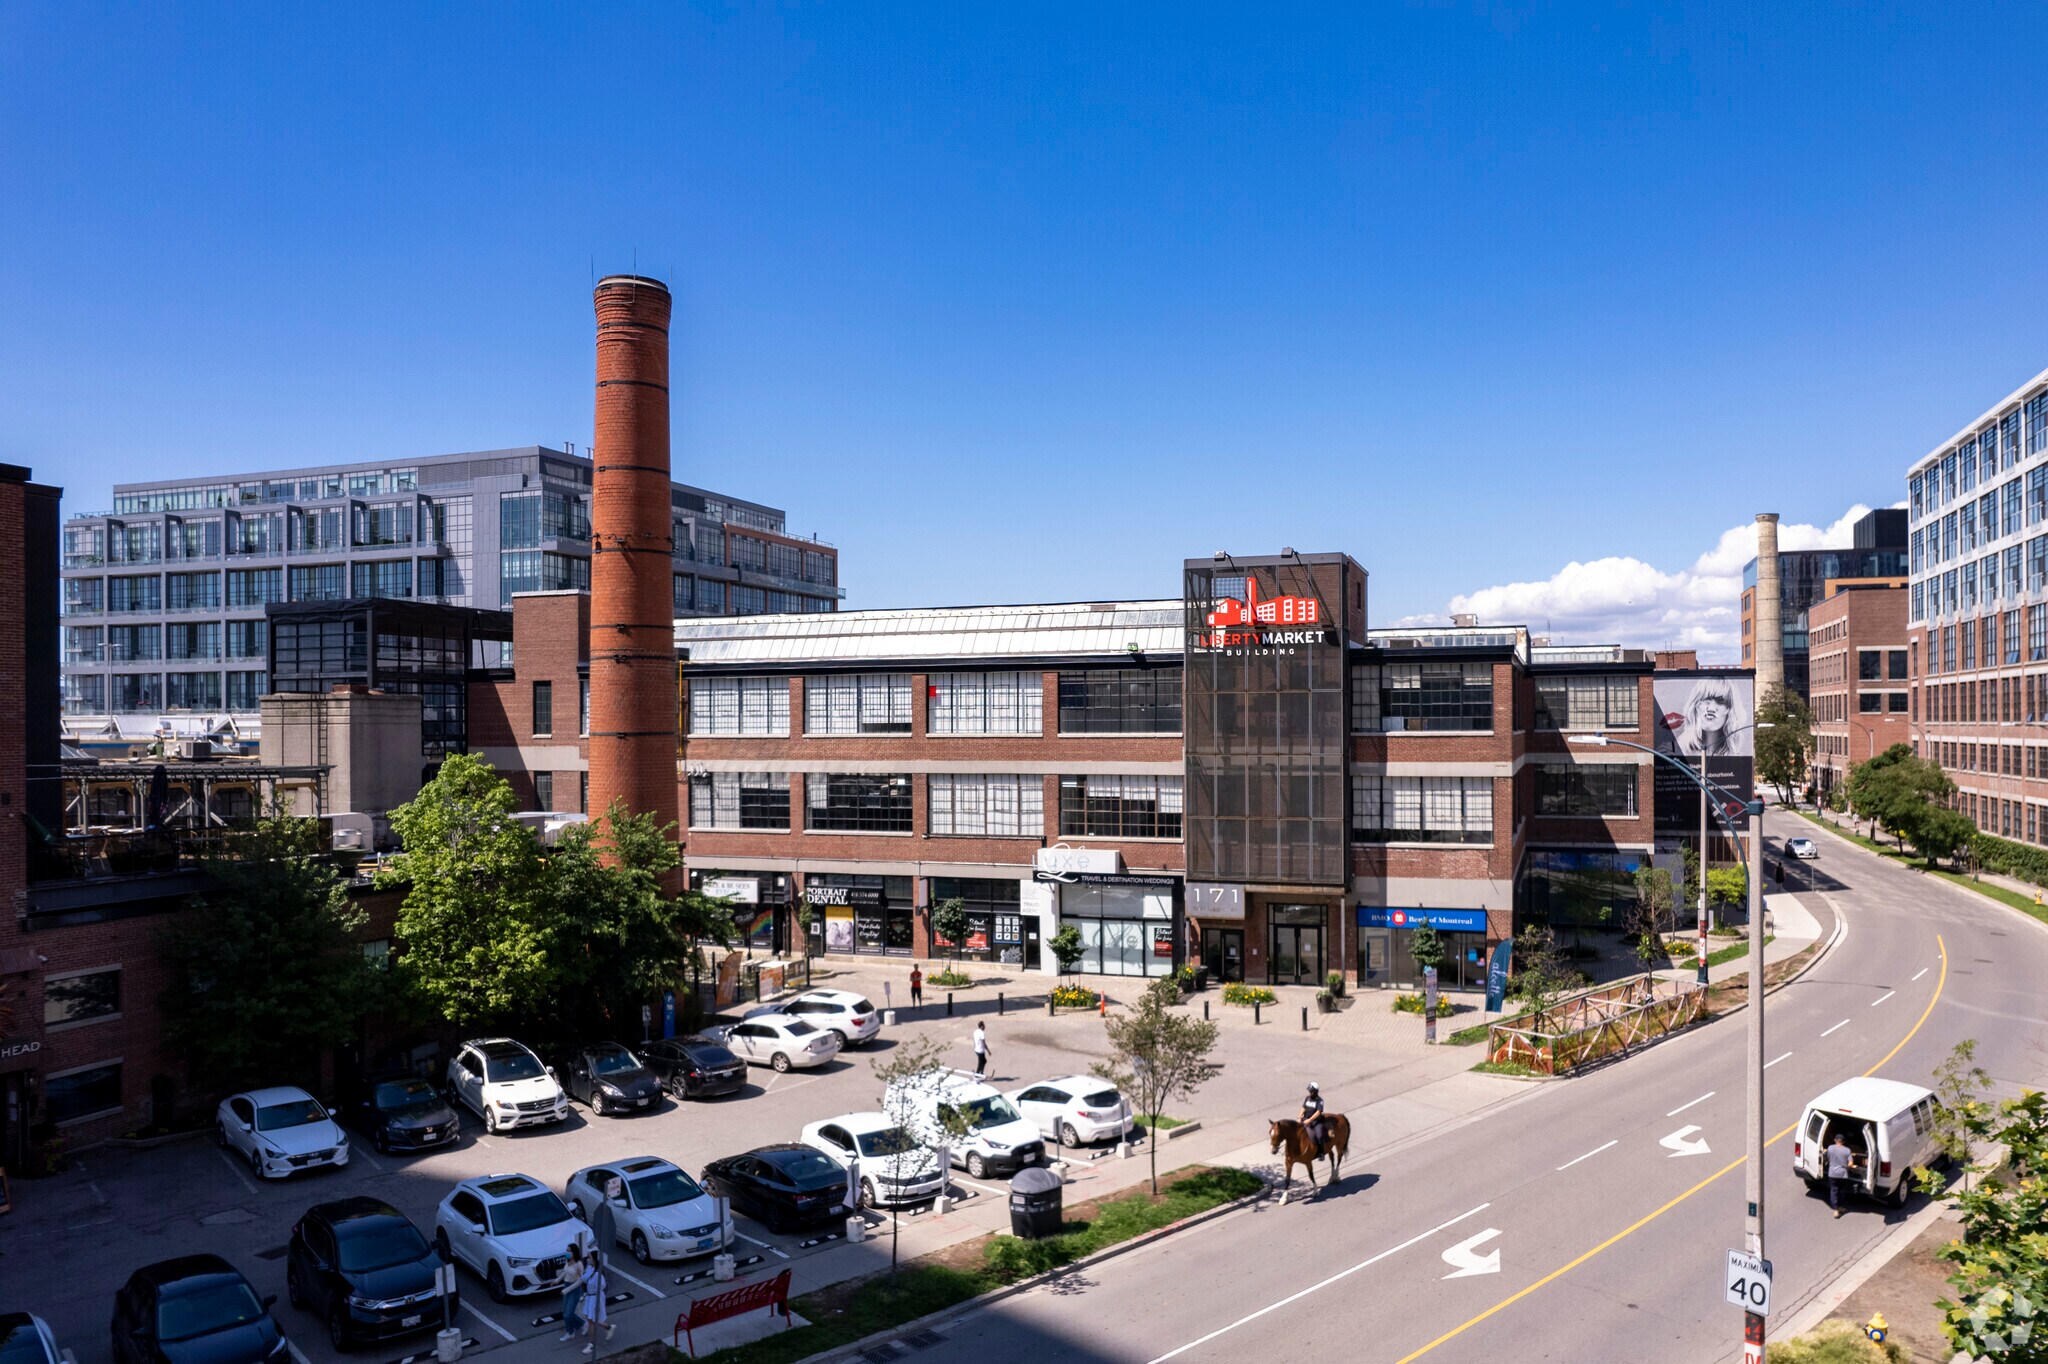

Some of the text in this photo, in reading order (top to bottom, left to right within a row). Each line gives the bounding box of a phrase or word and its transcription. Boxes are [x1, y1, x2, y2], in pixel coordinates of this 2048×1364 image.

[1200, 631, 1325, 647] LIBERTY MARKET
[1226, 648, 1295, 657] BUILDING
[807, 887, 848, 897] PORTRAIT
[807, 894, 848, 905] DENTAL
[1193, 888, 1238, 904] 171
[1371, 914, 1391, 922] BMO
[1438, 917, 1473, 925] Montreal
[1, 1041, 41, 1058] HEAD
[1731, 1257, 1768, 1274] MAXIMUM
[1730, 1277, 1766, 1306] 40
